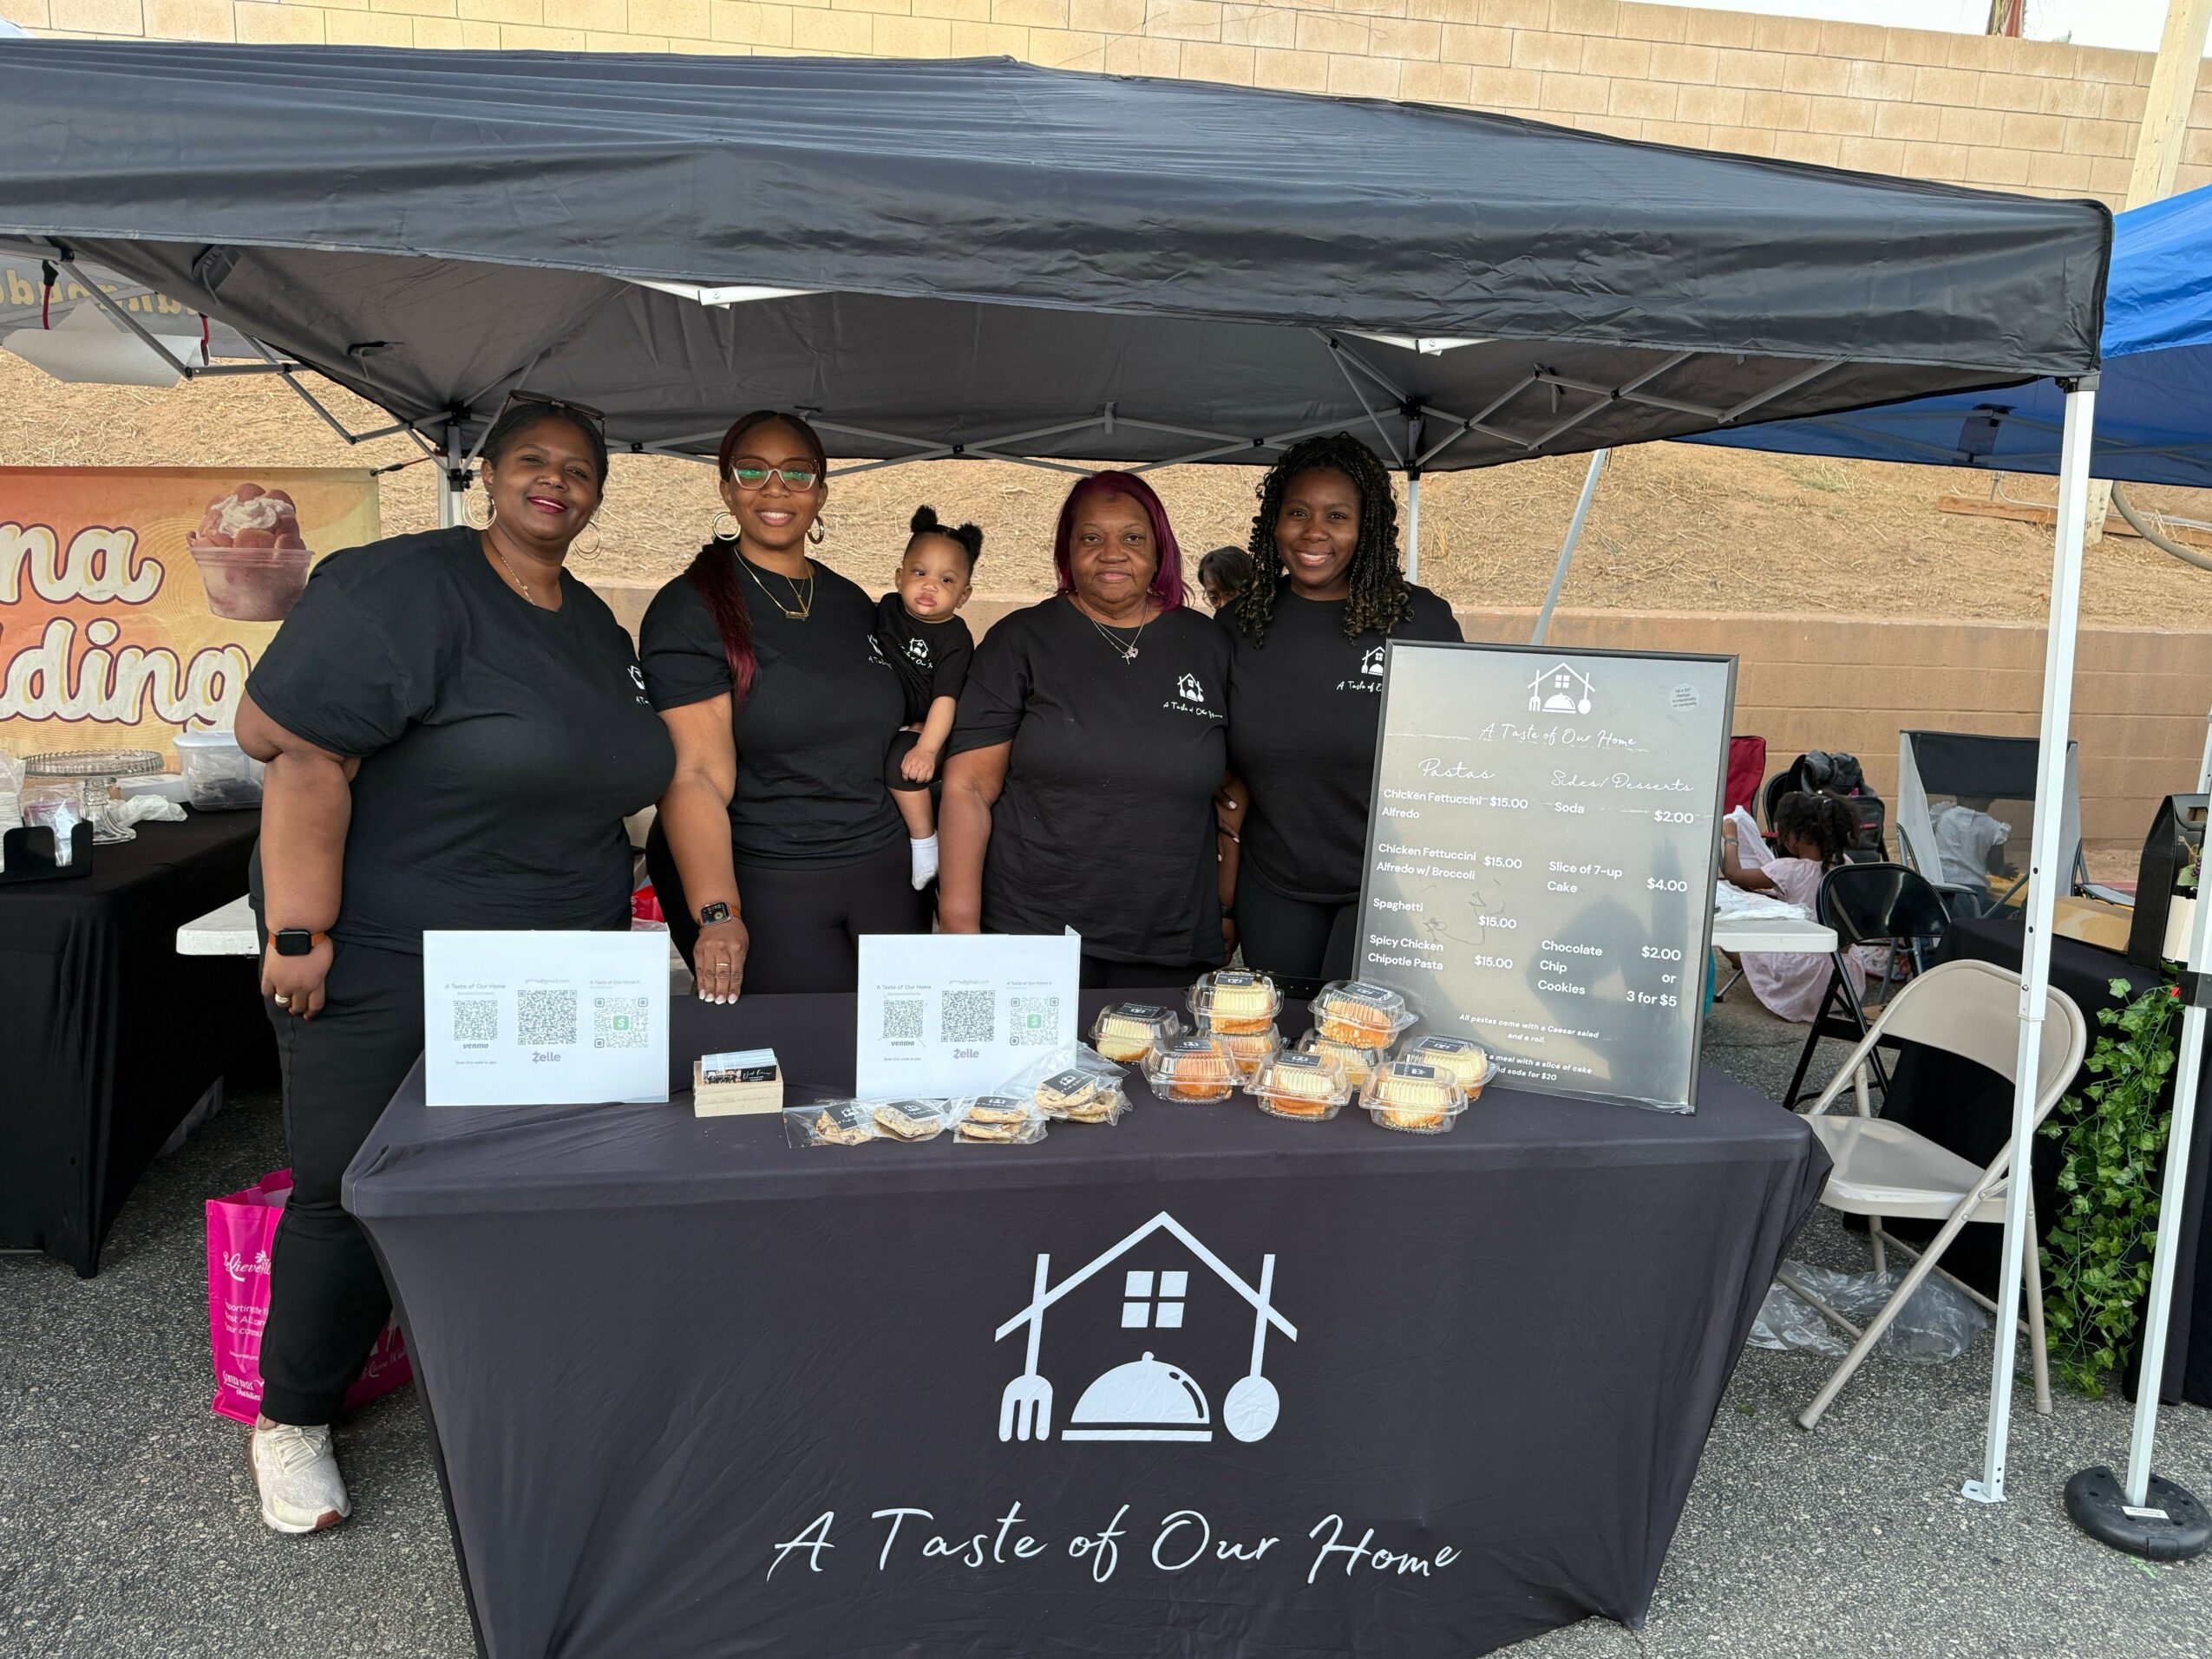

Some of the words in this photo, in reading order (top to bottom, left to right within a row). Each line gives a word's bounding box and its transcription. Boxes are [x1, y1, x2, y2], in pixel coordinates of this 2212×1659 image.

[0, 617, 252, 734] ding
[1337, 681, 1345, 690] A
[1479, 722, 1495, 740] A
[1501, 723, 1540, 741] Taste
[1543, 726, 1559, 746] of
[1561, 728, 1592, 743] Our
[1597, 729, 1638, 748] Home
[1417, 757, 1495, 779] Pastas
[1383, 788, 1426, 800] Chicken
[1428, 792, 1482, 806] Fettuccini
[1489, 795, 1528, 809] $15.00
[1381, 807, 1420, 819] Alfredo
[1554, 801, 1585, 813] Soda
[1653, 809, 1694, 824] $2.00
[1378, 843, 1421, 856] Chicken
[1423, 847, 1476, 861] Fettuccini
[1483, 855, 1522, 869] $15.00
[1376, 861, 1414, 874] Alfredo
[1416, 866, 1430, 877] w/
[1432, 866, 1476, 880] Broccoli
[1548, 861, 1577, 873] Slice
[1580, 864, 1592, 875] of
[1594, 865, 1623, 879] 7-up
[1547, 880, 1578, 893] Cake
[1646, 877, 1688, 892] $4.00
[1373, 898, 1423, 911] Spaghetti
[1478, 915, 1517, 929] $15.00
[1370, 934, 1399, 949] Spicy
[1400, 937, 1443, 951] Chicken
[1541, 940, 1603, 957] Chocolate
[1641, 945, 1682, 961] $2.00
[1368, 952, 1412, 966] Chipotle
[1413, 957, 1443, 970] Pasta
[1475, 954, 1513, 969] $15.00
[1540, 960, 1567, 975] Chip
[1661, 974, 1677, 984] or
[1537, 979, 1586, 995] Cookies
[1626, 990, 1635, 1002] 3
[1638, 992, 1658, 1004] for
[1659, 994, 1677, 1007] $5
[1470, 1016, 1496, 1025] pastas
[1498, 1019, 1520, 1028] come
[1522, 1022, 1539, 1030] with
[1548, 1025, 1576, 1035] Caesar
[1577, 1029, 1600, 1038] salad
[1508, 1032, 1523, 1041] and
[532, 1051, 561, 1063] Zelle
[953, 1048, 979, 1060] Zelle
[1495, 1054, 1515, 1063] meal
[1516, 1057, 1534, 1066] with
[1541, 1061, 1561, 1069] slice
[1572, 1065, 1593, 1074] cake
[1508, 1068, 1527, 1078] soda
[1528, 1070, 1541, 1079] for
[1541, 1072, 1557, 1081] $20
[766, 1511, 835, 1582] A
[872, 1500, 1048, 1571] Taste
[1068, 1504, 1130, 1583] of
[1152, 1510, 1280, 1571] Our
[1307, 1513, 1462, 1584] Home
